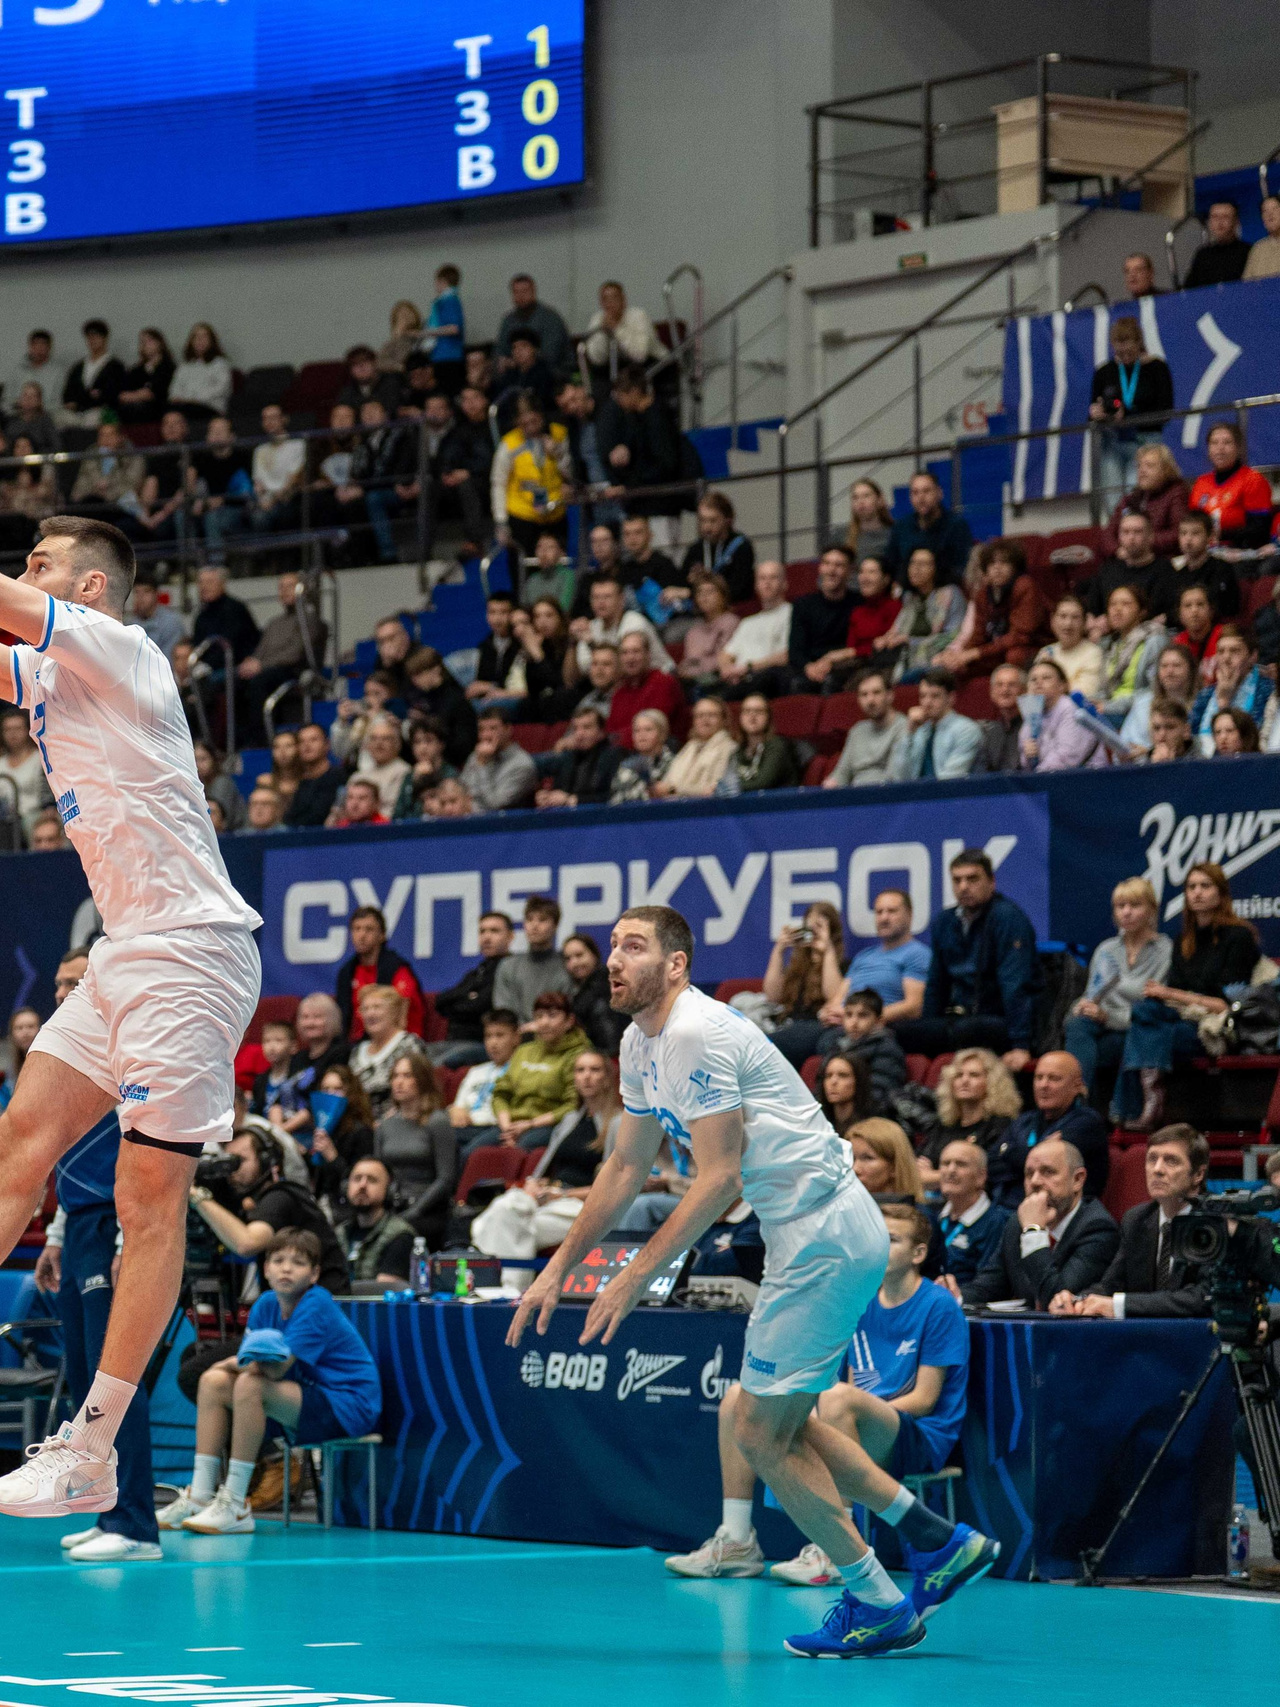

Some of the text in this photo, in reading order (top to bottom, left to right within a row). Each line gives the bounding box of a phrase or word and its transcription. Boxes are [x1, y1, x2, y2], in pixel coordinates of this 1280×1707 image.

[527, 24, 550, 68] 1
[522, 79, 559, 125] 0
[522, 134, 559, 180] 0
[545, 1351, 608, 1391] ВФВ
